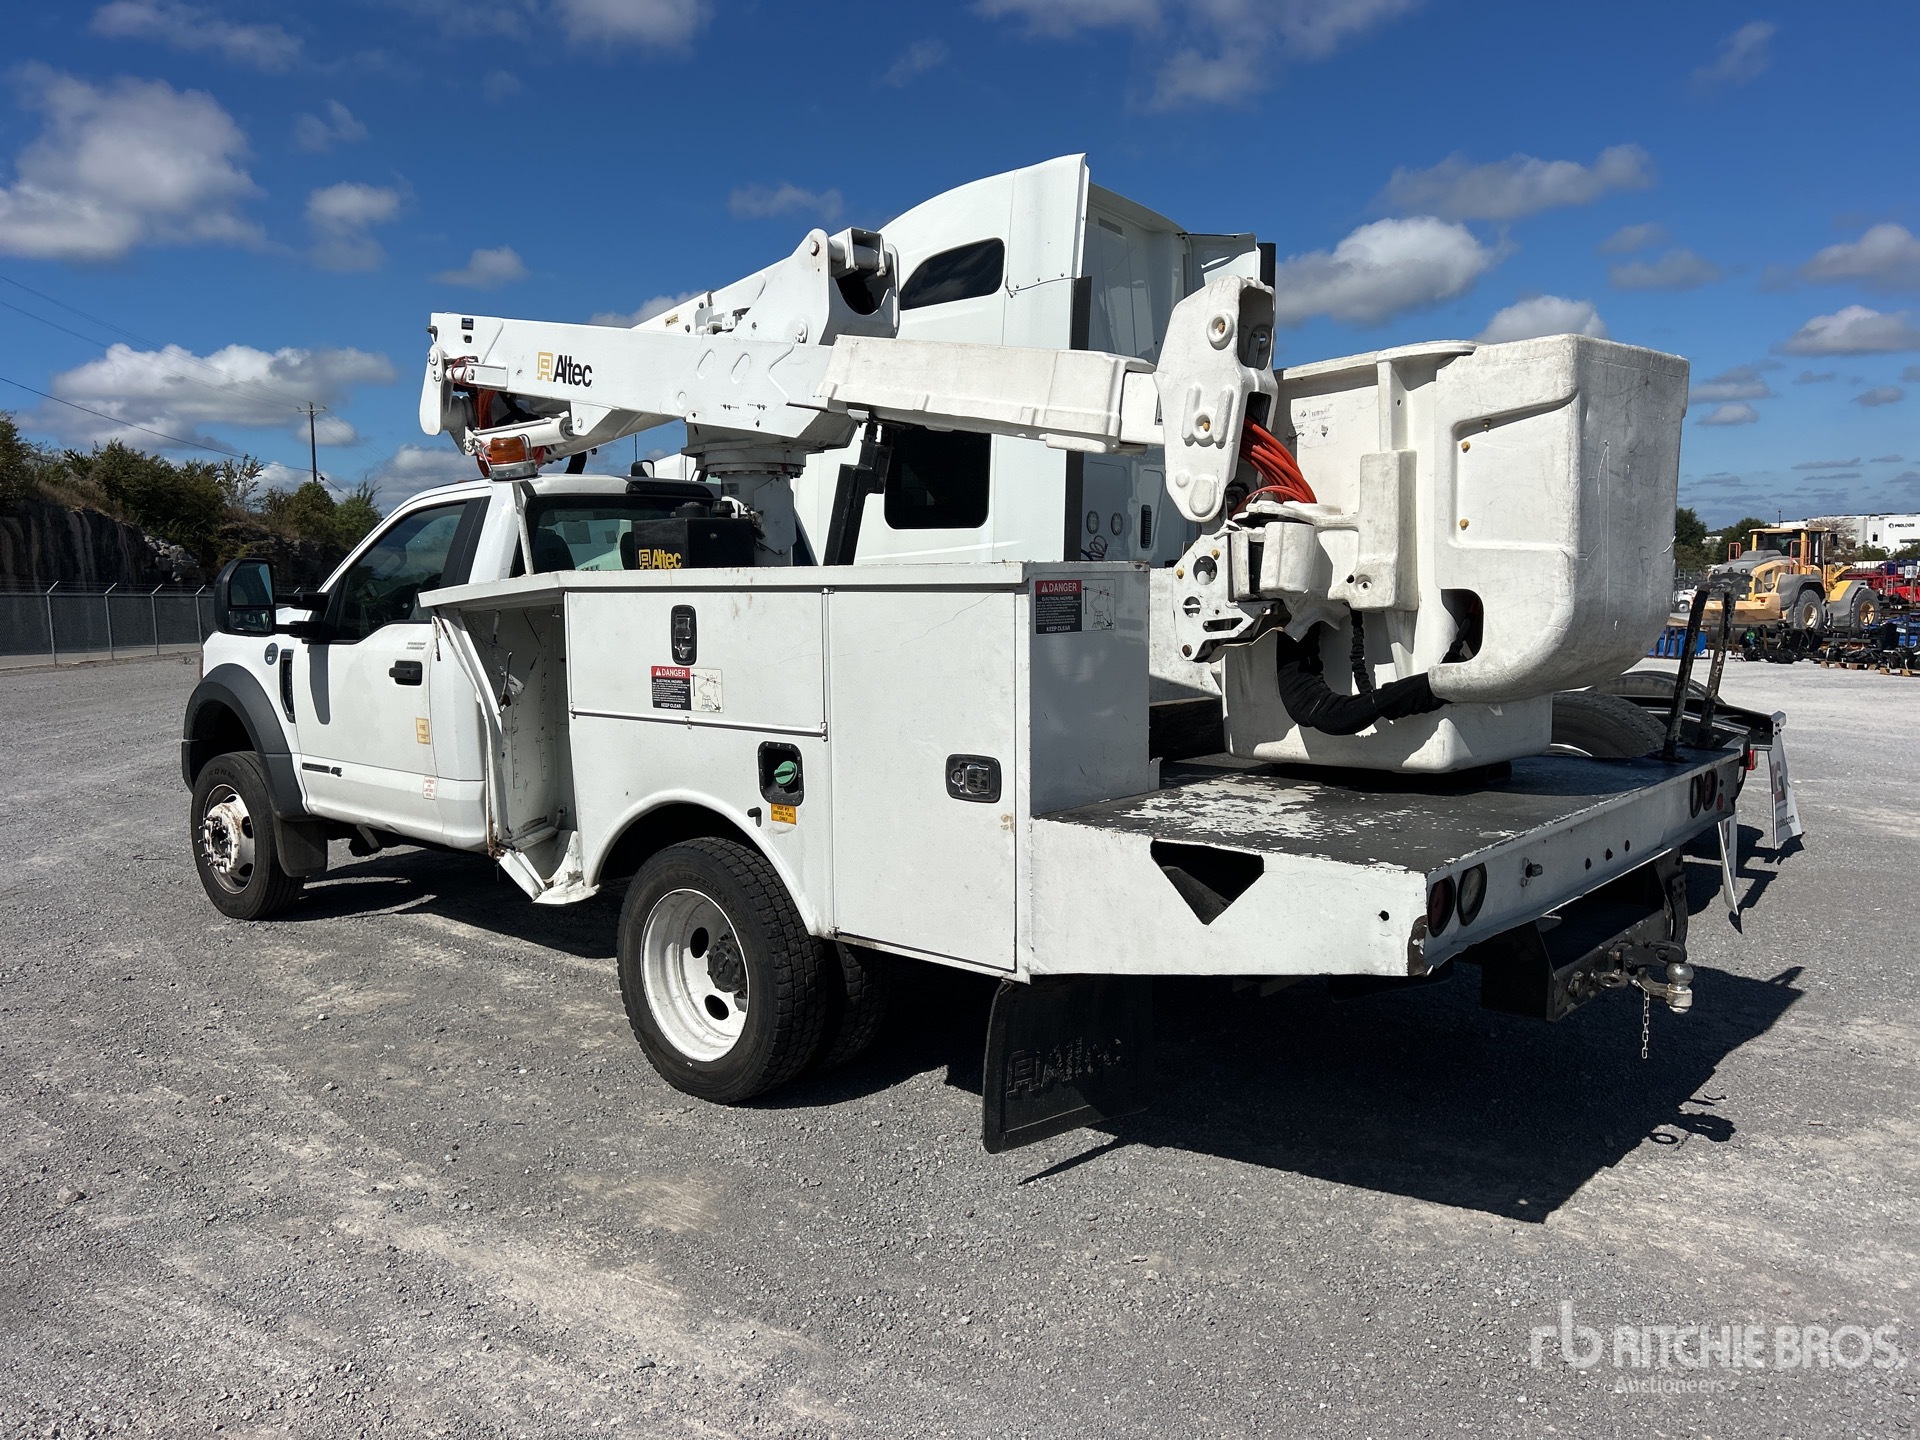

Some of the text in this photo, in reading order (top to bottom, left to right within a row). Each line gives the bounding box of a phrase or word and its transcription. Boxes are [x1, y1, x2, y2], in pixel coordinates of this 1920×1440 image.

[553, 354, 592, 388] Altec
[652, 549, 681, 569] Altec
[1049, 582, 1077, 593] DANGER
[661, 669, 686, 677] DANGER
